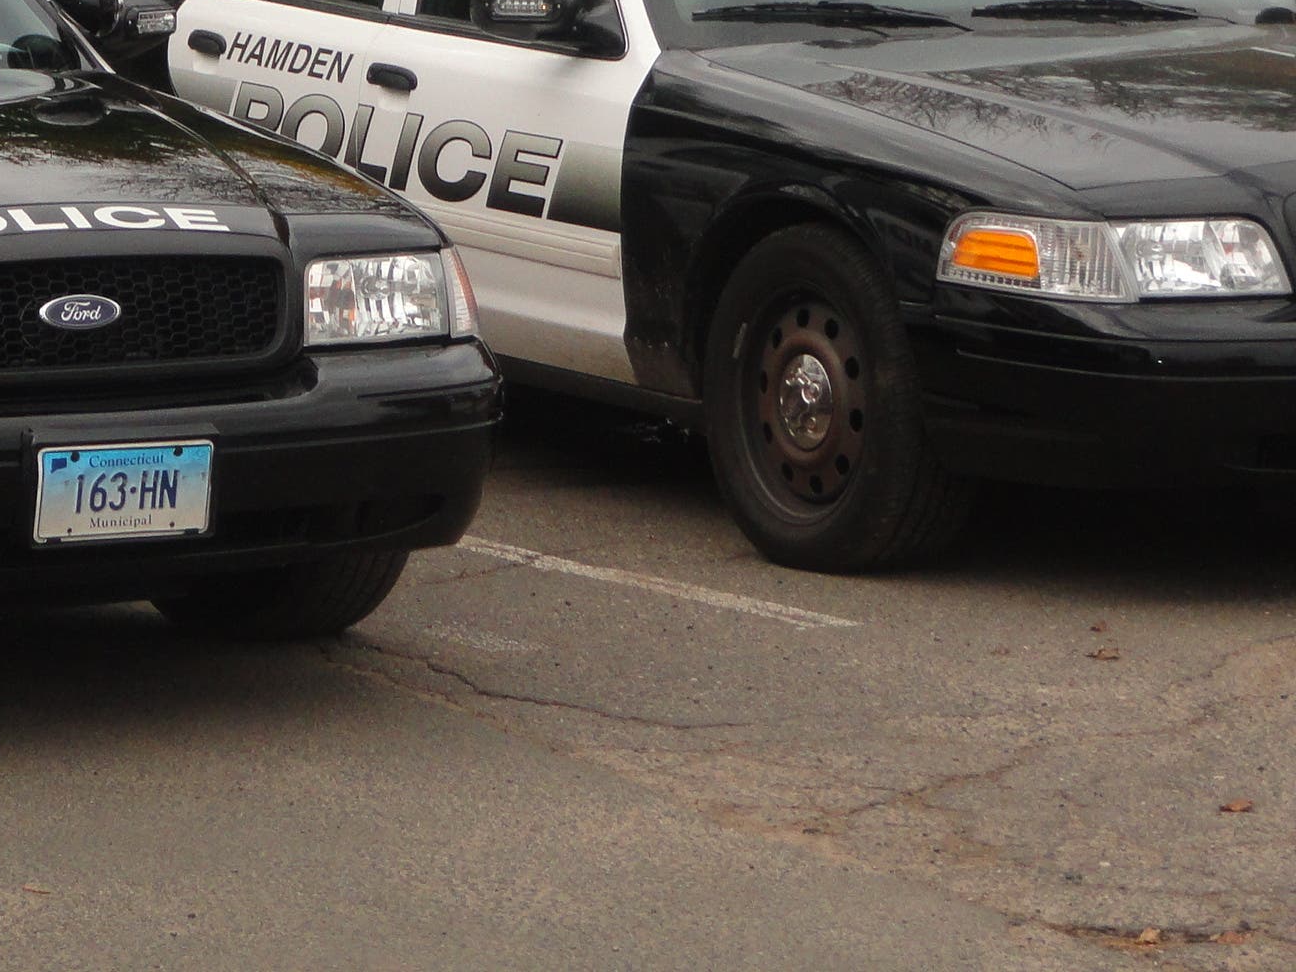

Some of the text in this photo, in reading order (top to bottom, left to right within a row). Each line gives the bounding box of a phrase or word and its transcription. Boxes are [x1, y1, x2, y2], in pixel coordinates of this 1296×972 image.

[227, 32, 354, 83] HAMDEN
[61, 301, 101, 321] Ford
[89, 453, 164, 468] Connecticut
[89, 515, 152, 529] Municipal
